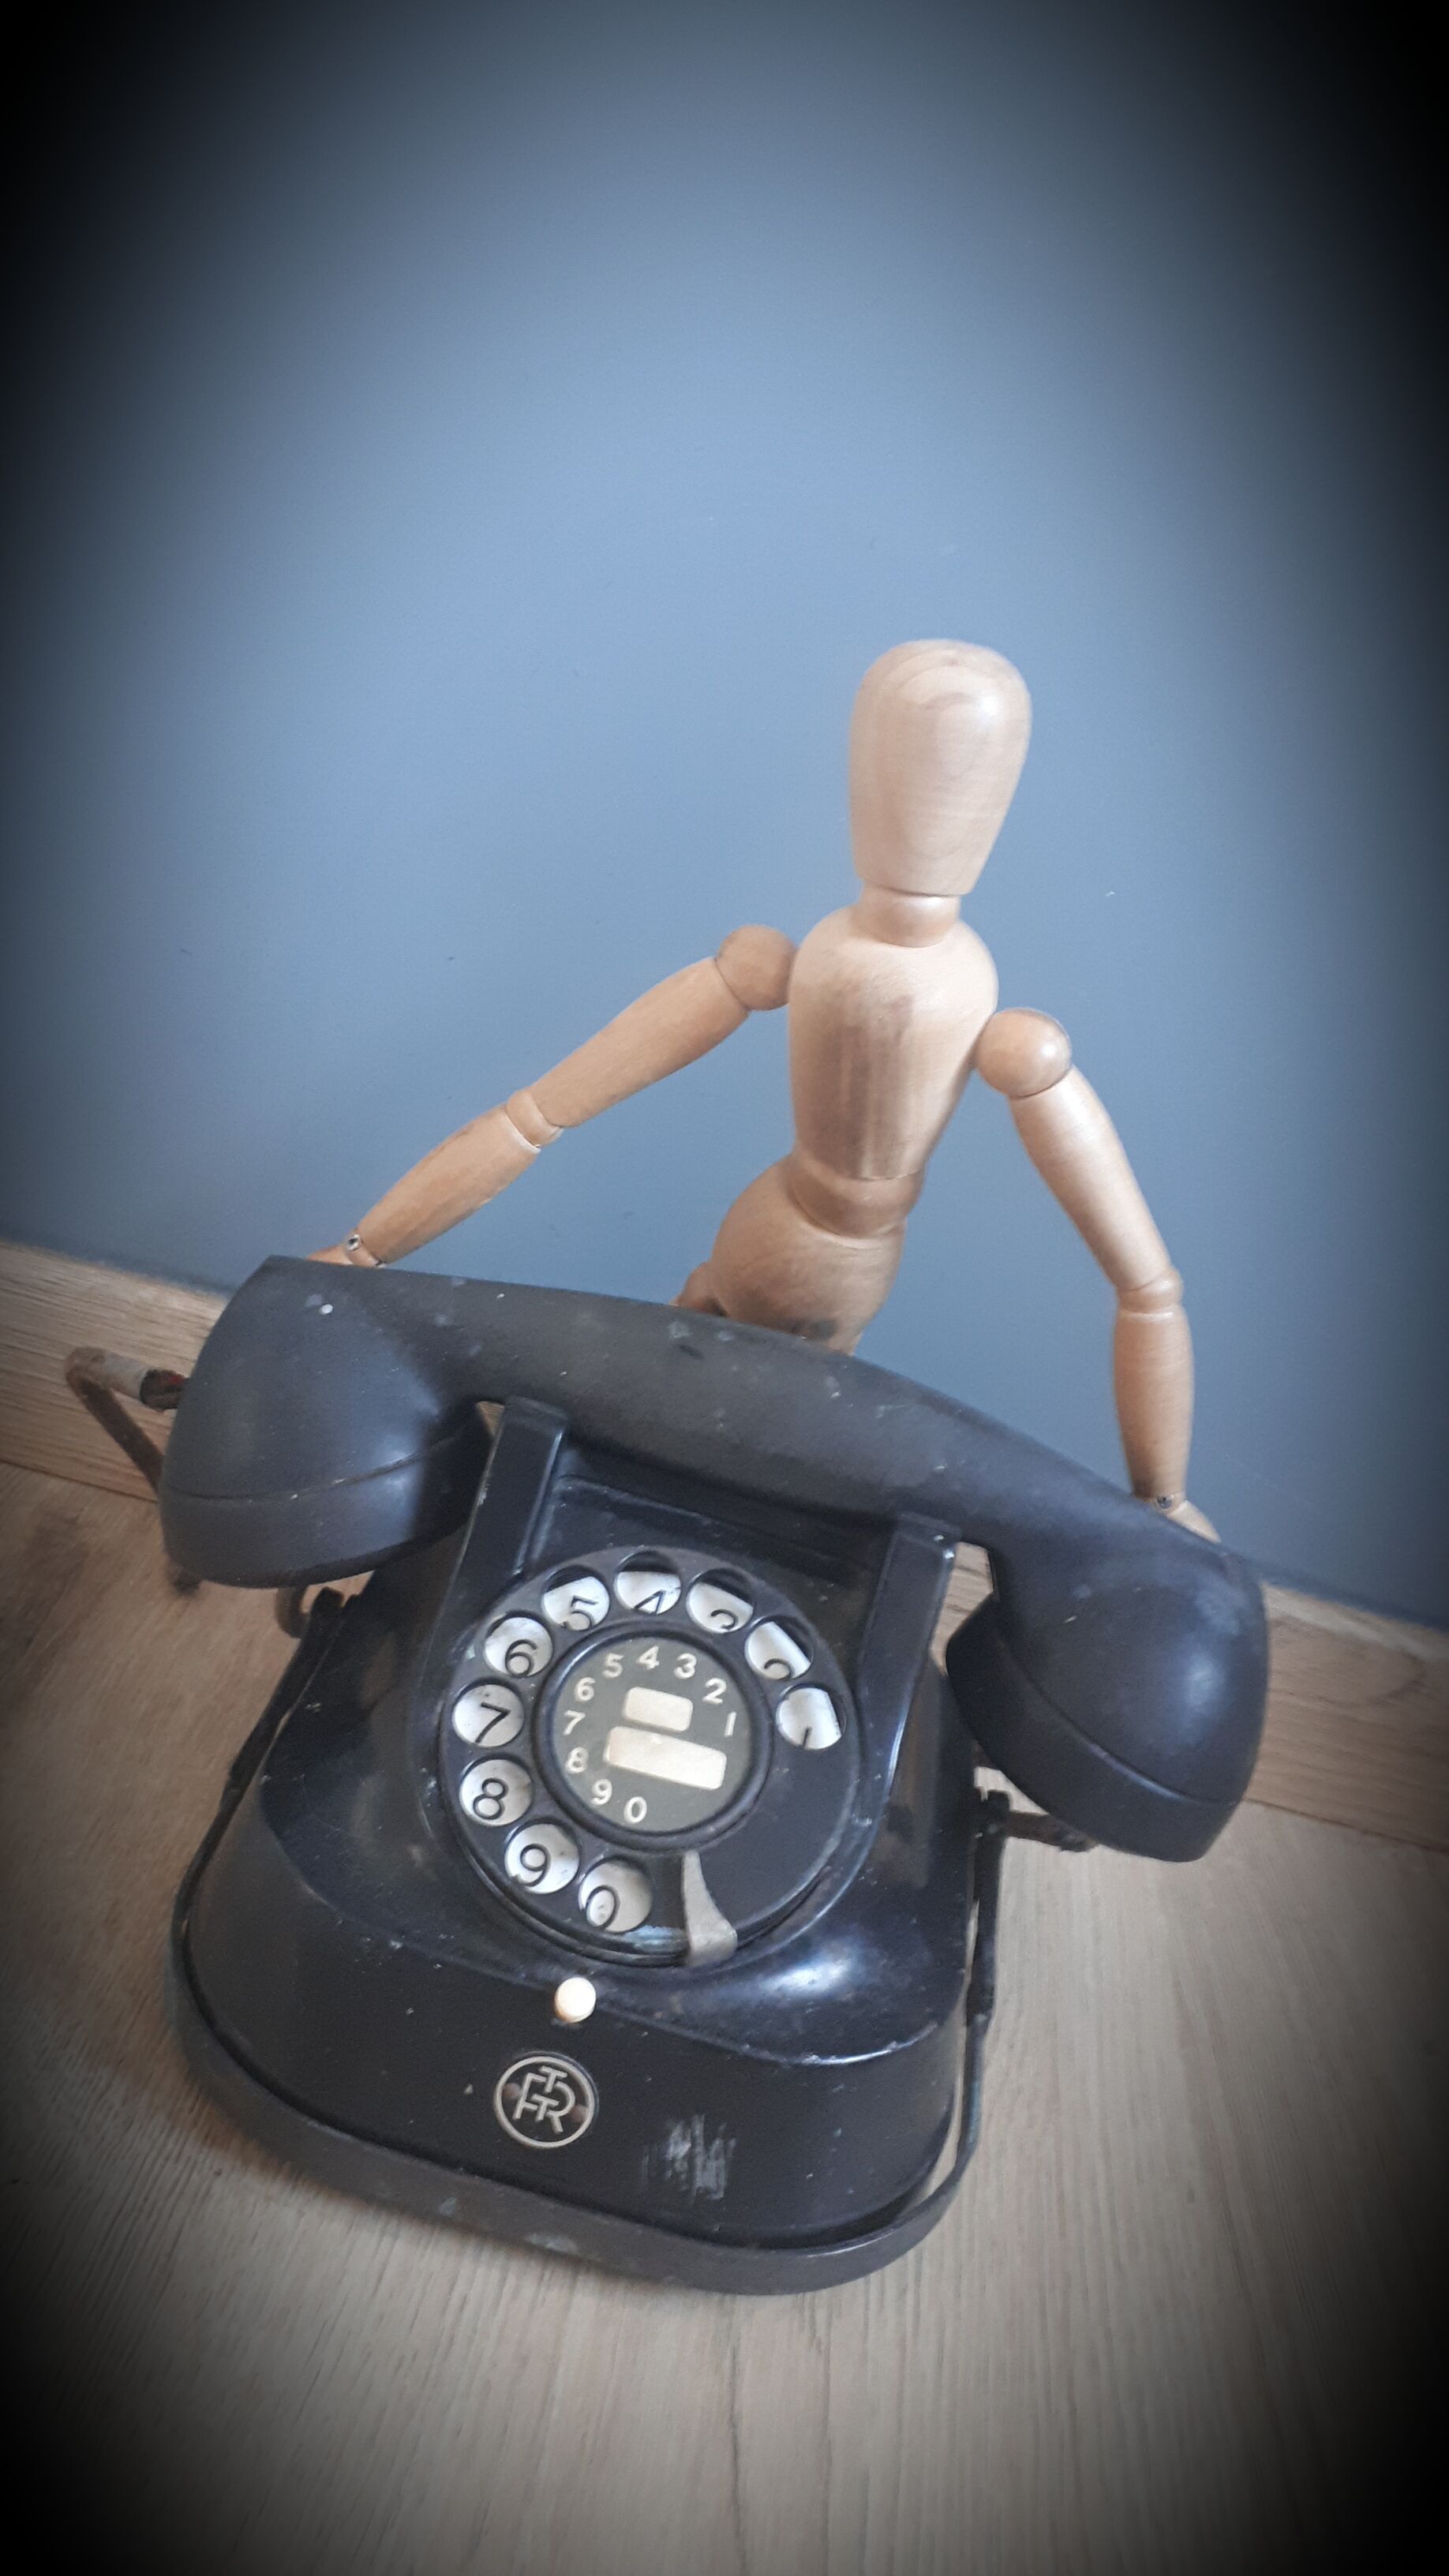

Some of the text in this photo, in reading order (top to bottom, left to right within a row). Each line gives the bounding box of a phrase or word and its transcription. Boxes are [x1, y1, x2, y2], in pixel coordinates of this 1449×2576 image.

[563, 1595, 597, 1631] 5
[505, 1639, 537, 1678] 6
[602, 1653, 623, 1678] 5
[636, 1646, 659, 1670] 4
[674, 1653, 697, 1679] 3
[575, 1677, 595, 1702] 6
[702, 1678, 727, 1704] 2
[475, 1702, 511, 1743] 7
[564, 1709, 586, 1735] 7
[724, 1711, 736, 1736] 1
[565, 1747, 589, 1773] 8
[473, 1777, 508, 1820] 8
[592, 1778, 612, 1805] 9
[623, 1796, 647, 1824] 0
[515, 1843, 551, 1887] 9
[586, 1885, 620, 1930] 0
